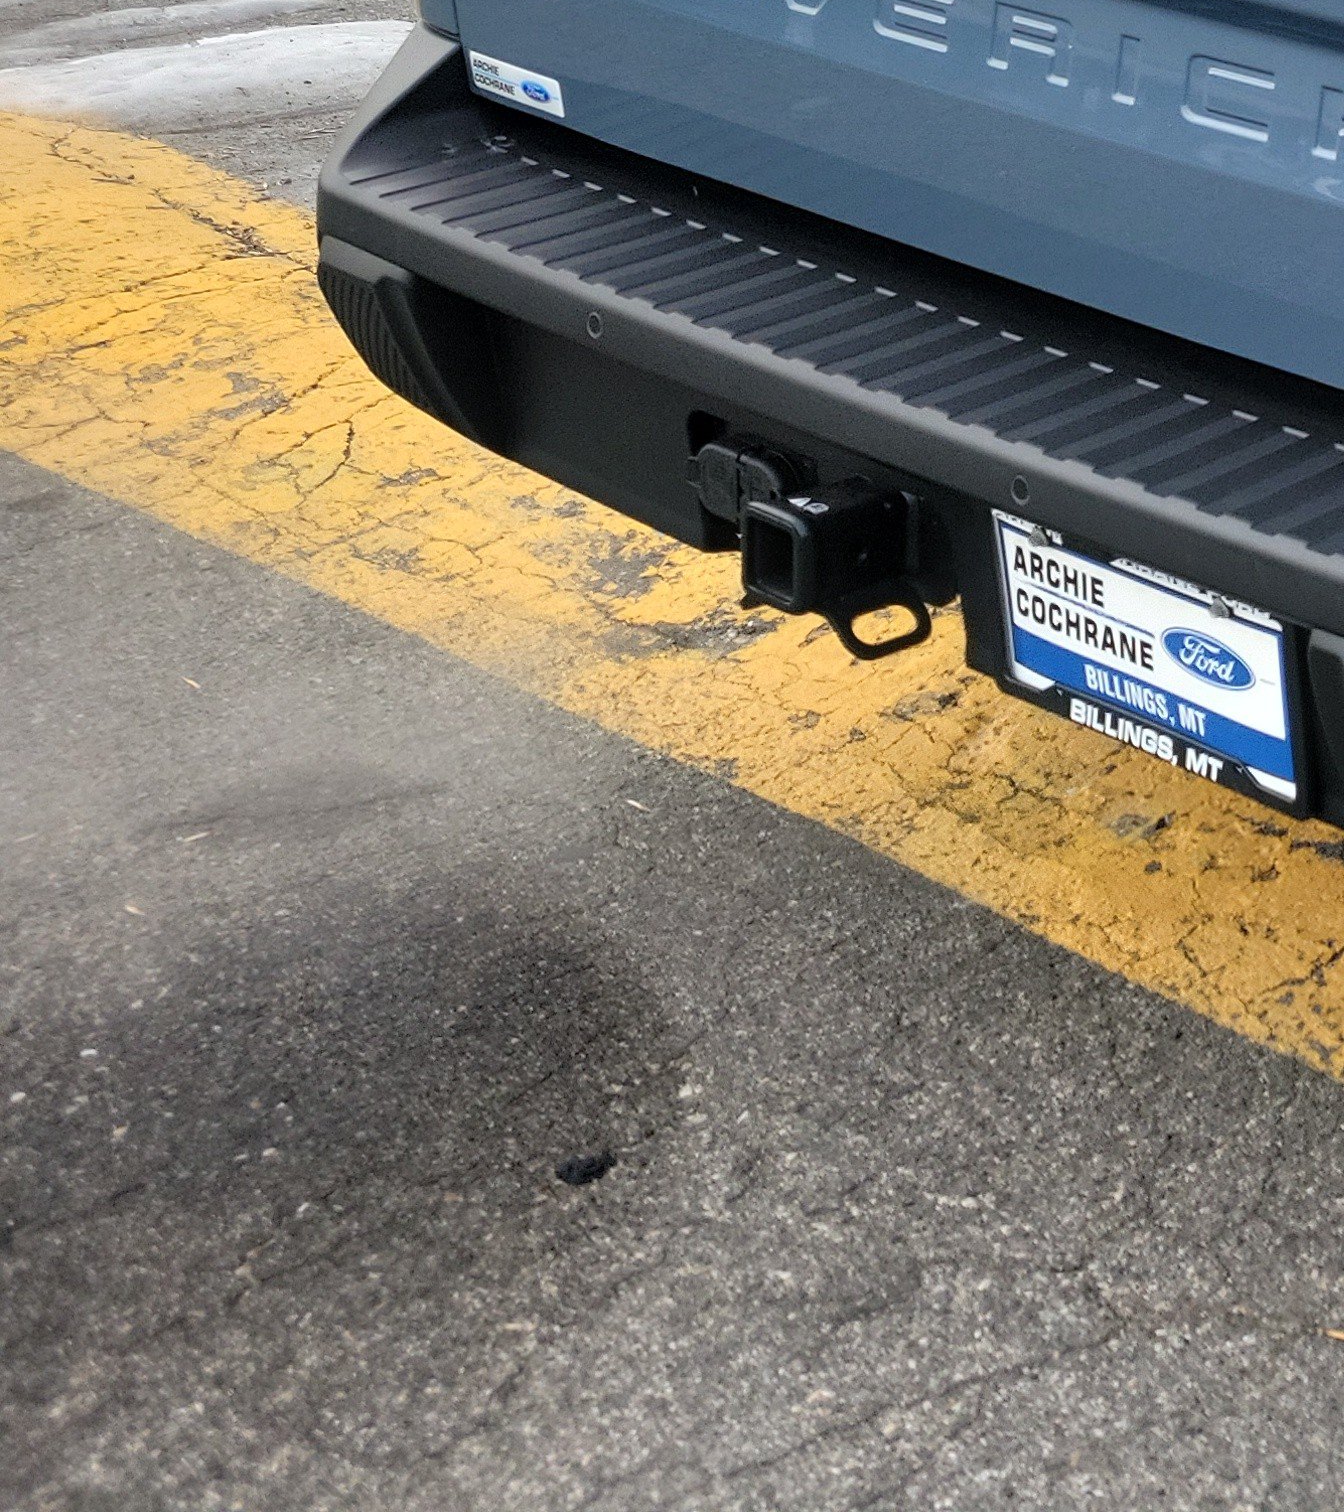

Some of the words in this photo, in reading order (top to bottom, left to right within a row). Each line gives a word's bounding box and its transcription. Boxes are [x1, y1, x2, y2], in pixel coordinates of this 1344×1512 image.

[473, 59, 500, 76] ARCHIE
[474, 73, 516, 96] COCHRANE
[1014, 545, 1104, 608] ARCHIE
[1016, 588, 1155, 671] COCHRANE
[1178, 635, 1236, 682] Ford
[1083, 663, 1176, 727] BILLINGS,
[1178, 703, 1206, 737] MT
[1069, 698, 1177, 766] BILLINGS,
[1185, 746, 1224, 782] MT
